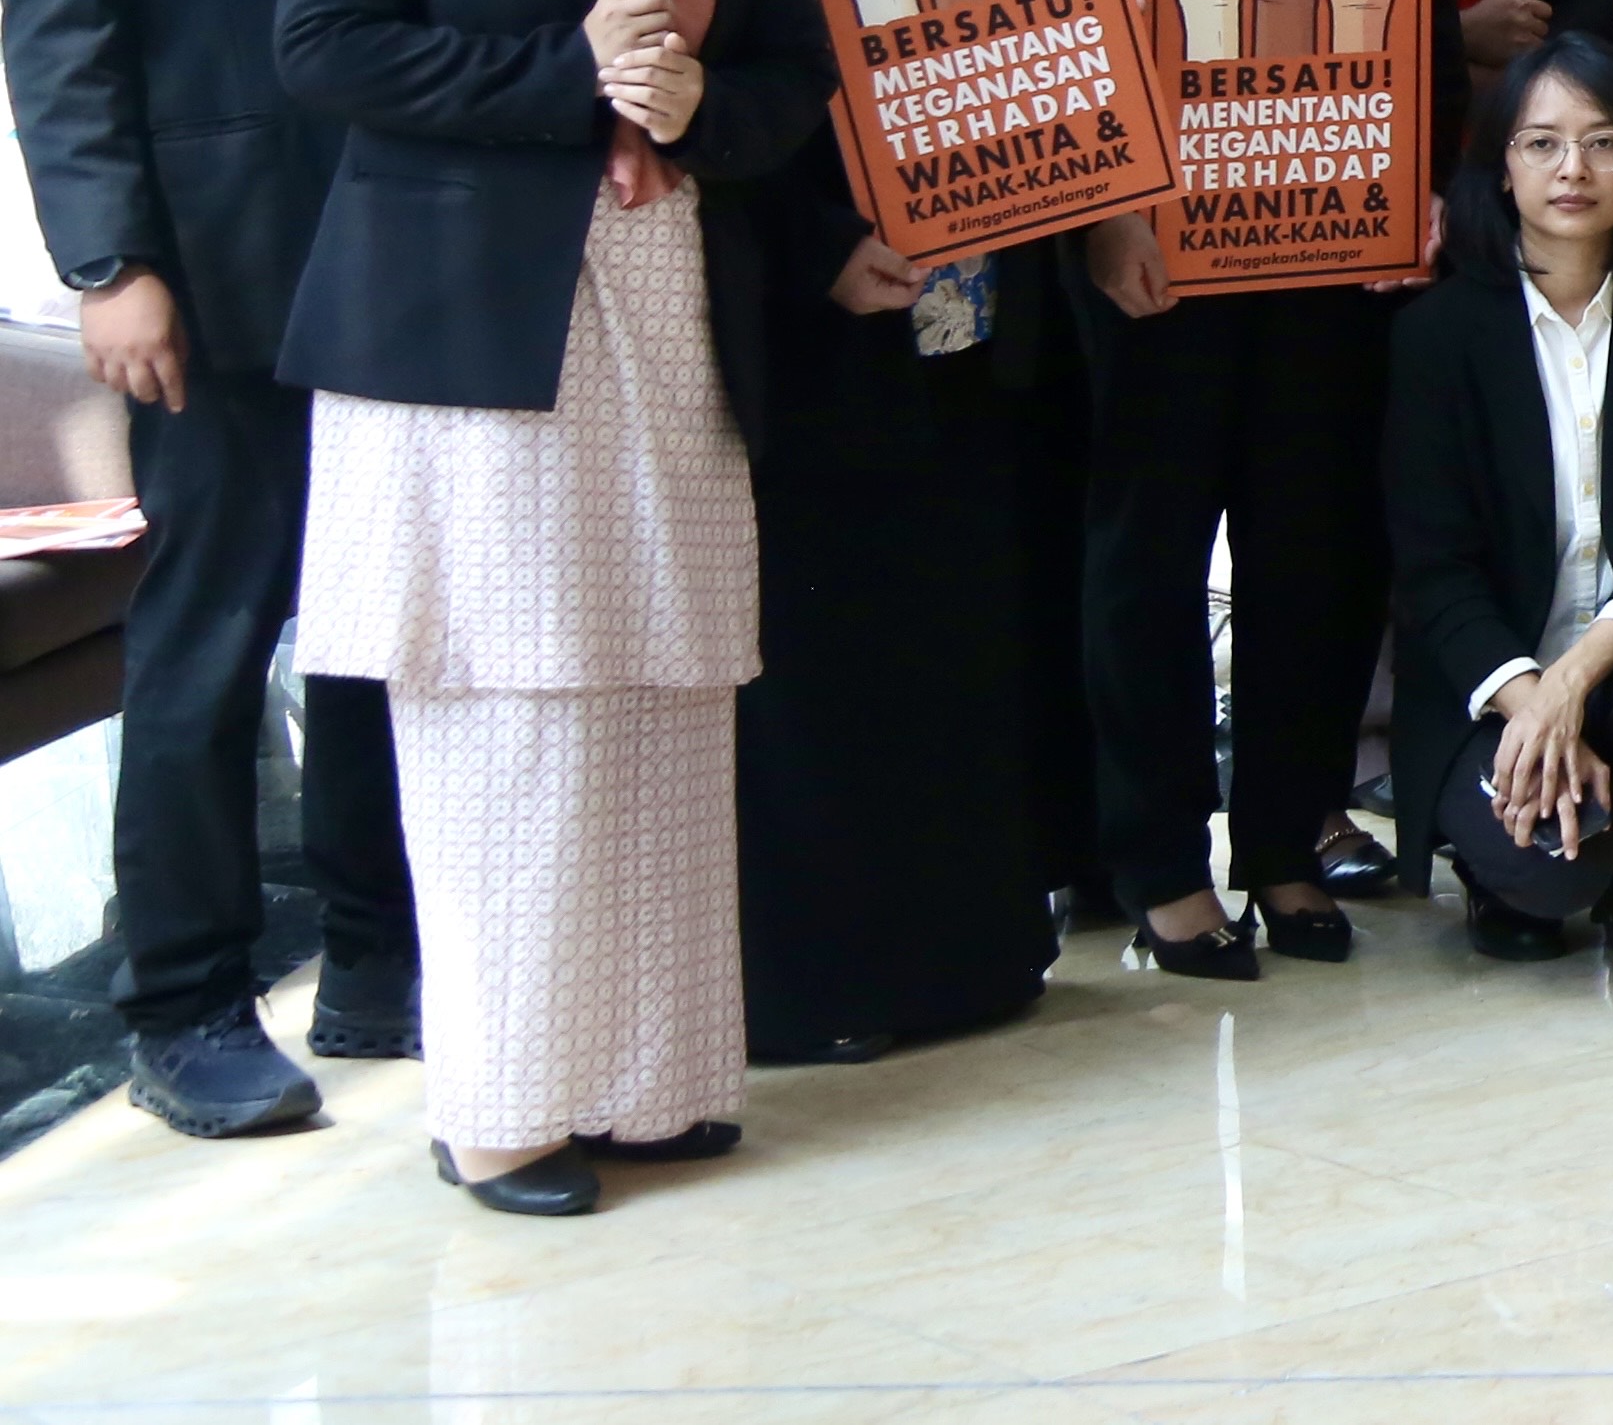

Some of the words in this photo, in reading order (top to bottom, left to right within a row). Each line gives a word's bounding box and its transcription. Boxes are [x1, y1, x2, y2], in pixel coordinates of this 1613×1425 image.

[874, 15, 1104, 99] MENENTANG
[878, 46, 1111, 130] KEGANASAN
[1181, 59, 1392, 99] BERSATU!
[887, 78, 1117, 161] TERHADAP
[1181, 92, 1393, 130] MENENTANG
[897, 123, 1080, 195] WANITA
[1098, 109, 1128, 142] &
[1179, 123, 1391, 160] KEGANASAN
[905, 142, 1134, 224] KANAK-KANAK
[1182, 153, 1391, 190] TERHADAP
[947, 182, 1110, 234] #JinggakanSelangor
[1182, 186, 1345, 224] WANITA
[1363, 182, 1389, 212] &
[1179, 216, 1389, 251] KANAK-KANAK
[1211, 248, 1362, 269] #JinggakanSelangor
